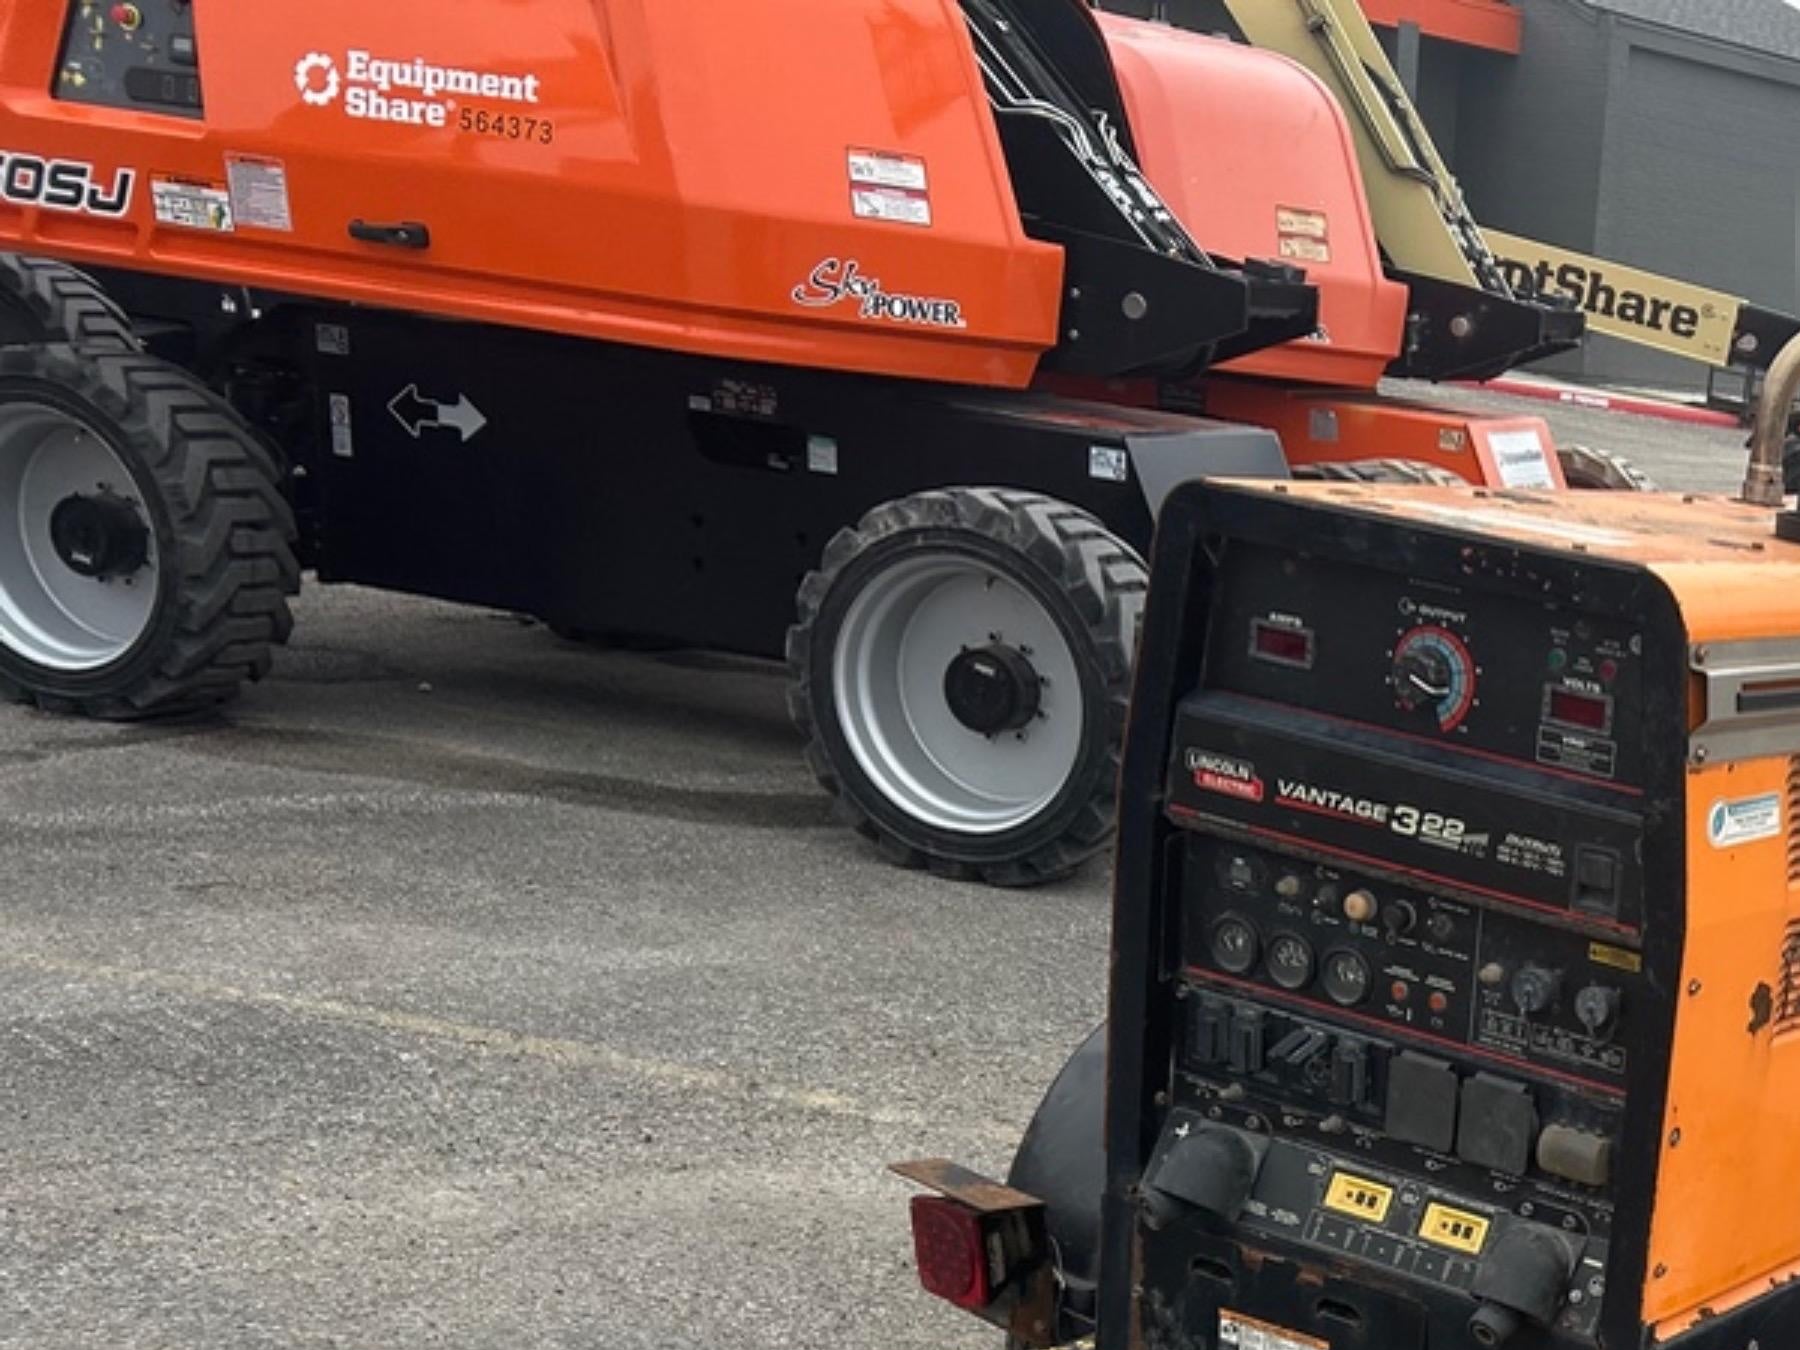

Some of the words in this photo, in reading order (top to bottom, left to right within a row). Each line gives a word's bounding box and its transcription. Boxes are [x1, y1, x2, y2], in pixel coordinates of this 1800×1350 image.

[346, 49, 540, 102] Equipment
[344, 87, 447, 128] Share
[458, 107, 554, 145] 564373
[0, 152, 134, 217] 0SJ
[870, 294, 961, 326] POWER
[1490, 255, 1699, 339] ntShare
[1276, 778, 1388, 824] VANTAGE
[1390, 803, 1466, 843] 322
